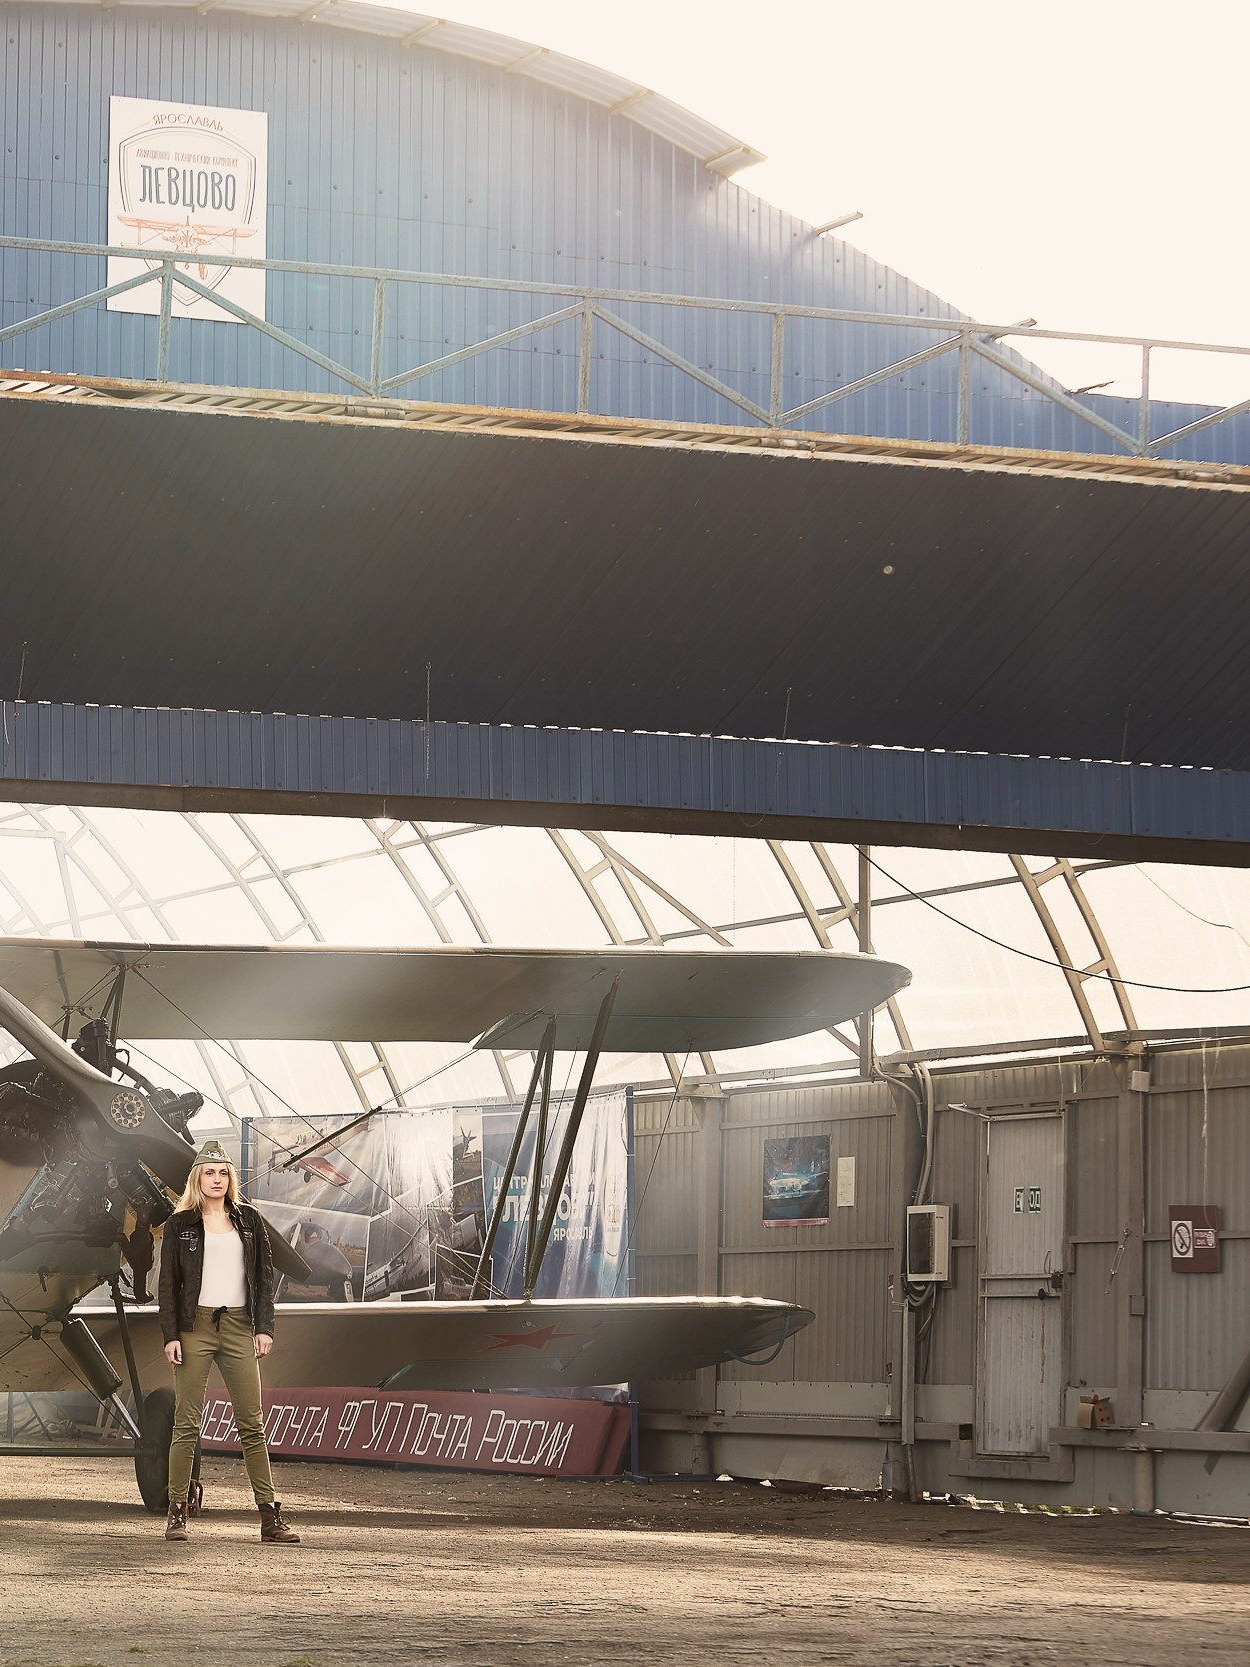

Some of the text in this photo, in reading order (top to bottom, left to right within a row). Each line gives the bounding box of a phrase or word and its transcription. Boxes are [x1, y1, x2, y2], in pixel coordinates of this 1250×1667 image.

[152, 113, 224, 132] ЯРОСЛАВЛЬ
[139, 164, 236, 214] ЛЕВЦОВО
[334, 1400, 405, 1453] ФГУП
